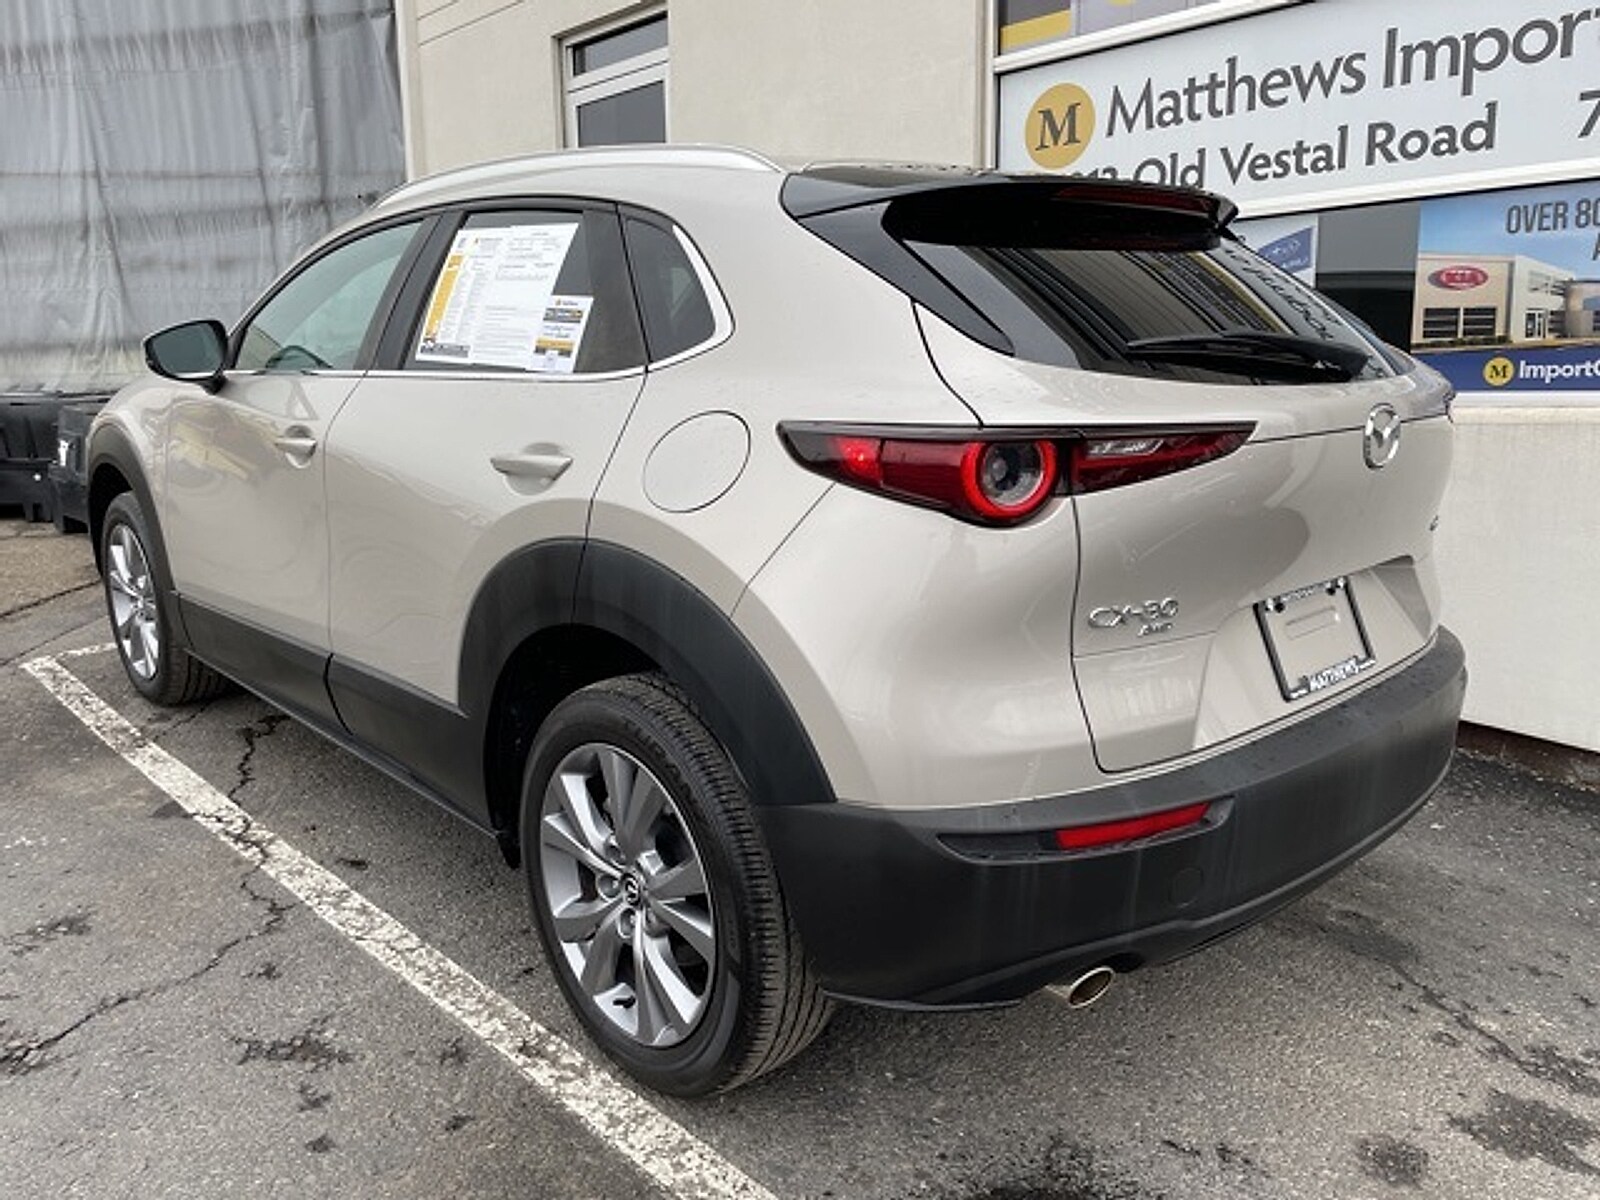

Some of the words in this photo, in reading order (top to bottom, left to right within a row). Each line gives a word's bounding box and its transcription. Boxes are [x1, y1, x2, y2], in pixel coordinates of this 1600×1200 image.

[1035, 102, 1081, 151] M
[1106, 52, 1366, 138] Matthews
[1383, 8, 1600, 97] Impor
[1133, 147, 1206, 188] Old
[1220, 124, 1348, 186] Vestal
[1366, 101, 1498, 167] Road
[1506, 202, 1569, 234] OVER
[1088, 597, 1178, 629] CX-30
